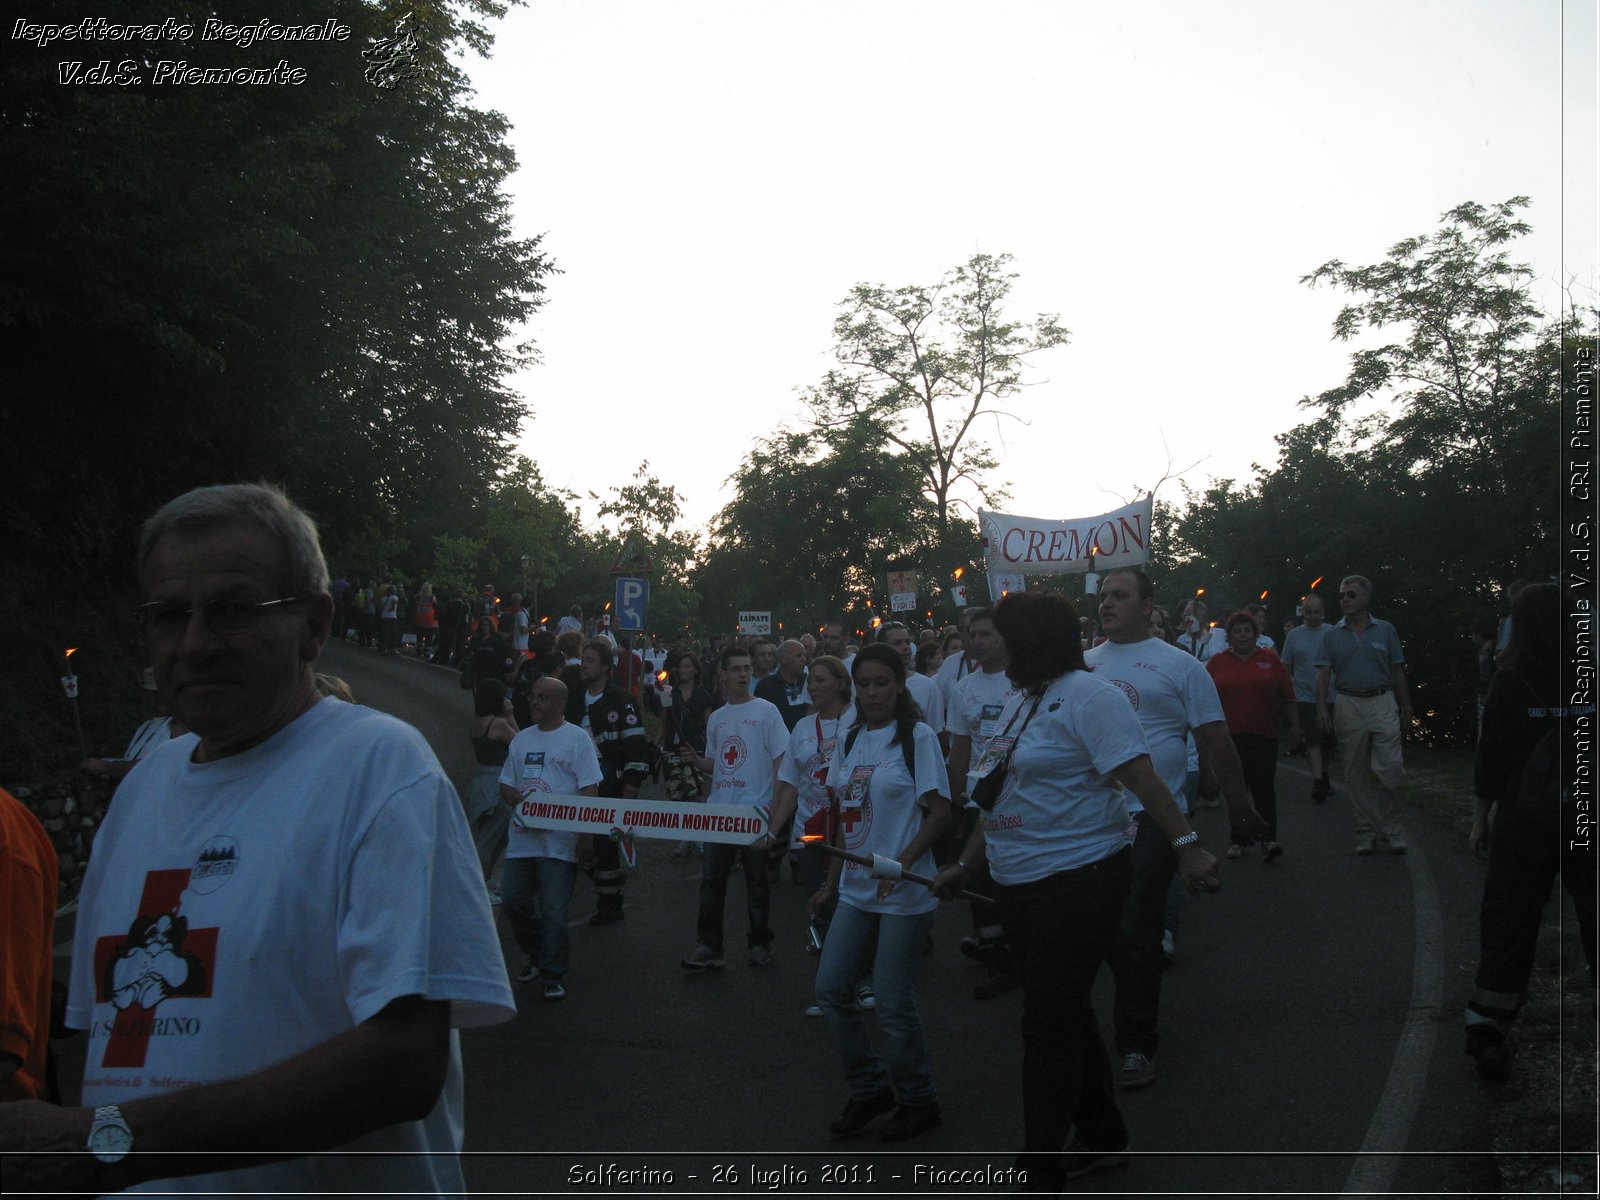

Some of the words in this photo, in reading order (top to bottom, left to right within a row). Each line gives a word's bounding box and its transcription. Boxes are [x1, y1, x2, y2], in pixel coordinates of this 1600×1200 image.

[1002, 514, 1150, 562] CREMON
[623, 581, 643, 606] P
[521, 801, 577, 821] COMITATO
[579, 806, 616, 824] LOCALE
[622, 809, 680, 829] GUIDONIA
[681, 812, 762, 834] MONTECELIO
